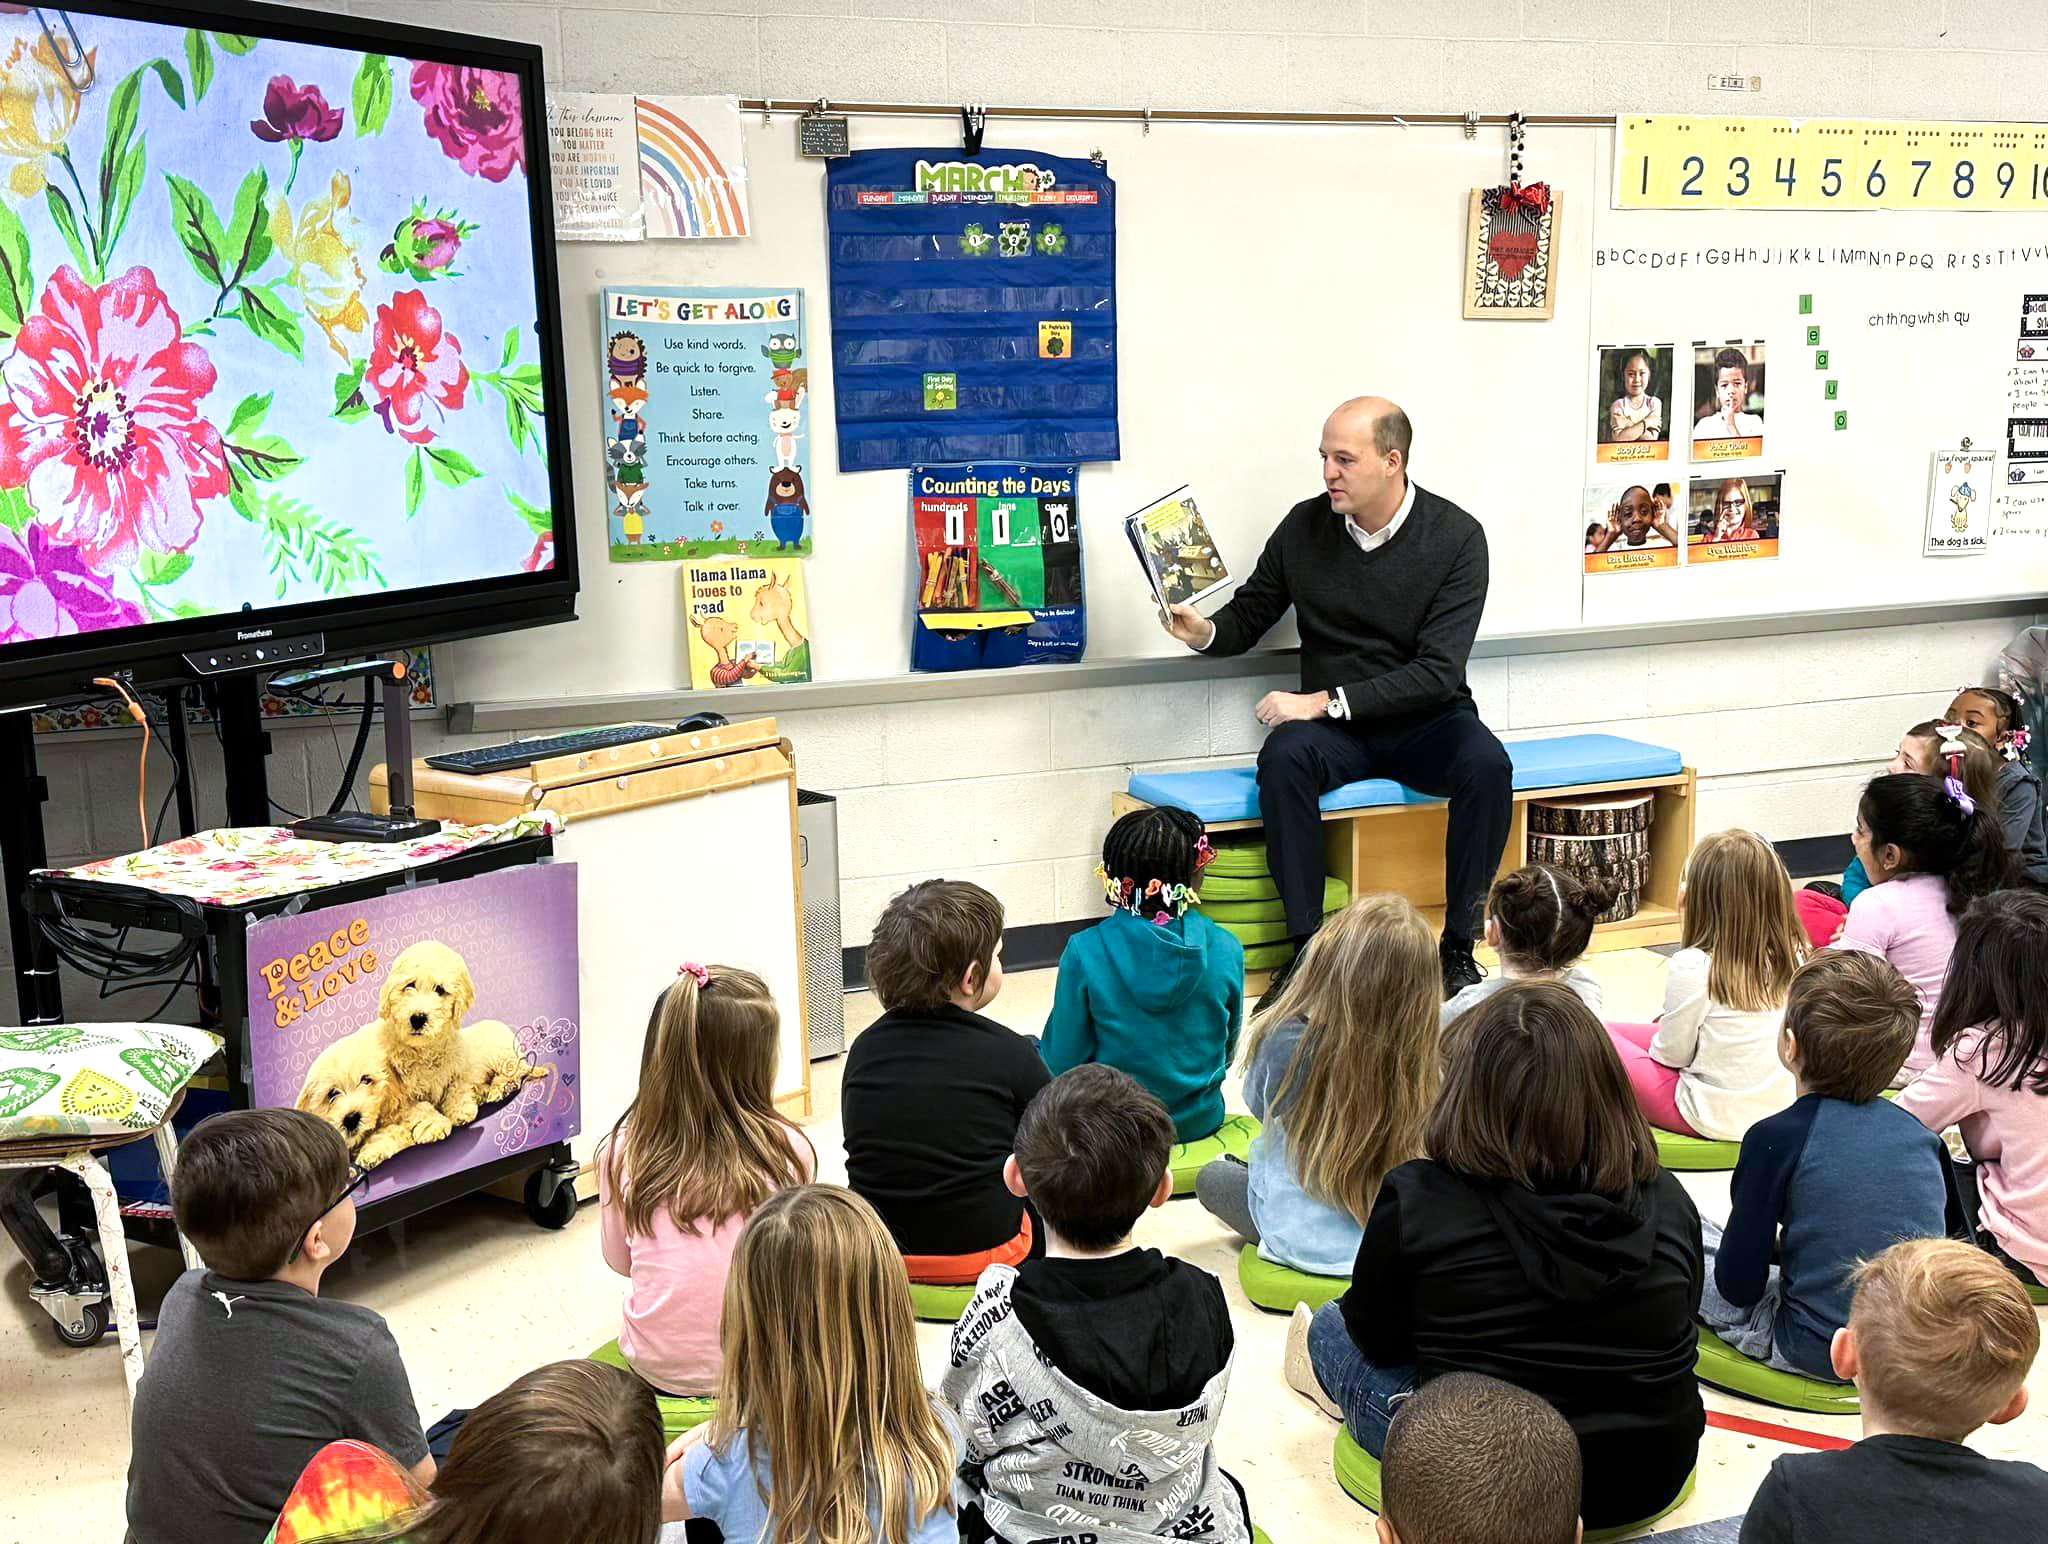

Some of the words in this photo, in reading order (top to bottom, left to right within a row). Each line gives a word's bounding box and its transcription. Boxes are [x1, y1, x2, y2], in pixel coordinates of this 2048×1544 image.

[550, 127, 564, 137] YOU
[566, 127, 593, 138] BELONG
[596, 128, 614, 138] HERE
[562, 140, 577, 149] YOU
[579, 141, 605, 150] MATTER
[567, 153, 580, 162] ARE
[565, 166, 578, 175] ARE
[580, 166, 619, 176] IMPORTANT
[1641, 155, 1649, 195] 1
[1681, 155, 1705, 196] 2
[1726, 156, 1750, 196] 3
[1775, 157, 1796, 196] 4
[1821, 158, 1842, 197] 5
[1866, 159, 1886, 198] 6
[1911, 160, 1932, 198] 7
[1953, 160, 1975, 199] 8
[1996, 161, 2015, 199] 9
[559, 178, 573, 188] YOU
[590, 178, 612, 188] LOVED
[920, 164, 1026, 191] MARCH
[862, 194, 888, 202] SUNDAY
[615, 296, 671, 320] LET'S
[677, 302, 718, 321] GET
[724, 298, 791, 320] ALONG
[1868, 313, 1884, 326] ch
[1886, 312, 1898, 325] th
[1900, 314, 1916, 327] ng
[1918, 311, 1935, 324] wh
[1937, 310, 1949, 323] sh
[1954, 311, 1970, 327] qu
[1809, 330, 1818, 341] e
[664, 337, 684, 350] Use
[687, 337, 709, 350] kind
[712, 337, 746, 350] words.
[1818, 354, 1827, 365] a
[656, 362, 670, 373] Be
[672, 361, 700, 376] quick
[702, 362, 715, 373] to
[718, 362, 757, 376] forgive.
[690, 386, 721, 396] Listen.
[1827, 383, 1836, 395] u
[692, 408, 725, 420] Share.
[1837, 414, 1845, 425] o
[658, 431, 686, 443] Think
[688, 431, 723, 443] before
[726, 432, 759, 445] acting.
[666, 455, 721, 469] Encourage
[724, 454, 758, 465] others.
[684, 478, 707, 489] Take
[711, 479, 738, 489] turns.
[921, 477, 999, 496] Counting
[1002, 477, 1026, 493] the
[1031, 479, 1071, 496] Days
[684, 500, 704, 511] Talk
[706, 501, 714, 511] it
[717, 501, 741, 511] over.
[921, 502, 969, 512] hundreds
[999, 501, 1016, 511] tens
[1053, 513, 1065, 538] 0
[1930, 537, 1945, 547] The
[1946, 537, 1961, 547] dog
[1963, 537, 1968, 545] is
[690, 569, 727, 582] llama
[730, 567, 767, 581] llama
[692, 585, 727, 598] loves
[730, 584, 742, 596] to
[693, 600, 725, 614] read
[237, 629, 273, 640] Promethean
[259, 917, 370, 1000] Peace
[273, 995, 301, 1029] &
[297, 948, 378, 1013] Love
[1056, 1483, 1085, 1502] THAN
[1088, 1492, 1110, 1506] YOU
[1112, 1495, 1148, 1513] THINK
